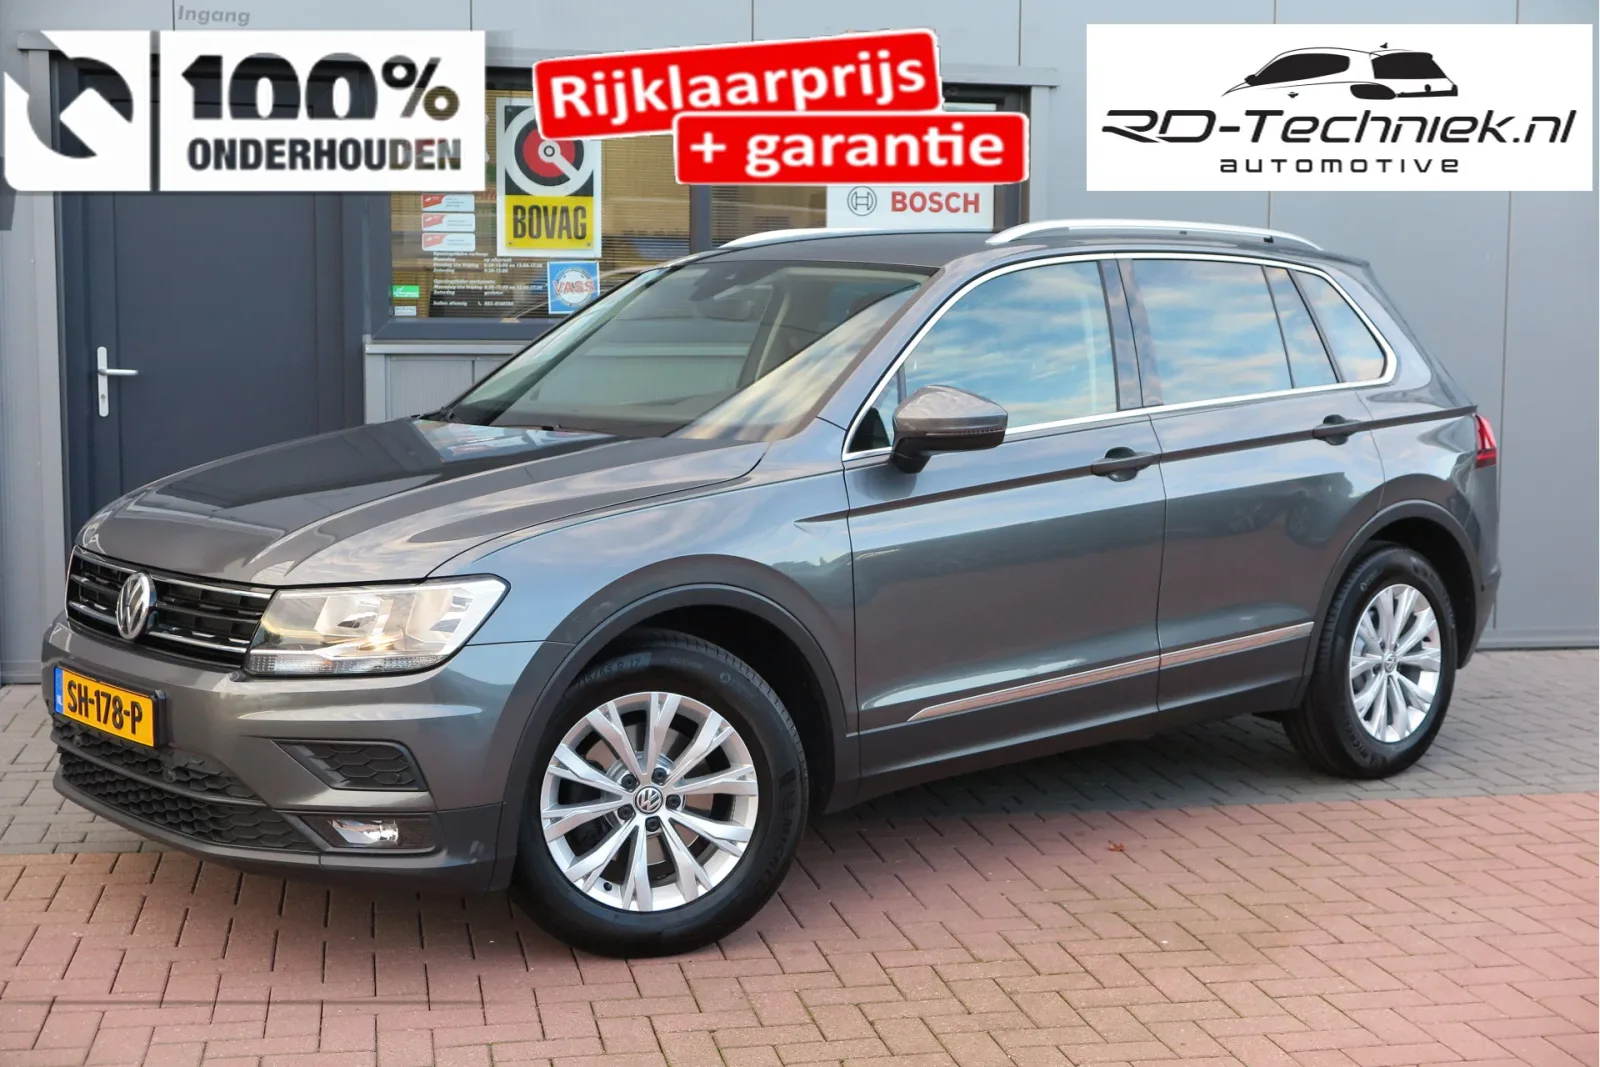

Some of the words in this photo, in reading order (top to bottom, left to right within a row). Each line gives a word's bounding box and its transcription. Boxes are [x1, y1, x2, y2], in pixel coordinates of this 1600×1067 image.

[177, 5, 250, 26] Ingang
[891, 191, 980, 213] BOSCH
[513, 205, 587, 240] BOVAG
[553, 280, 595, 293] VASS
[67, 679, 143, 735] SH-178-P
